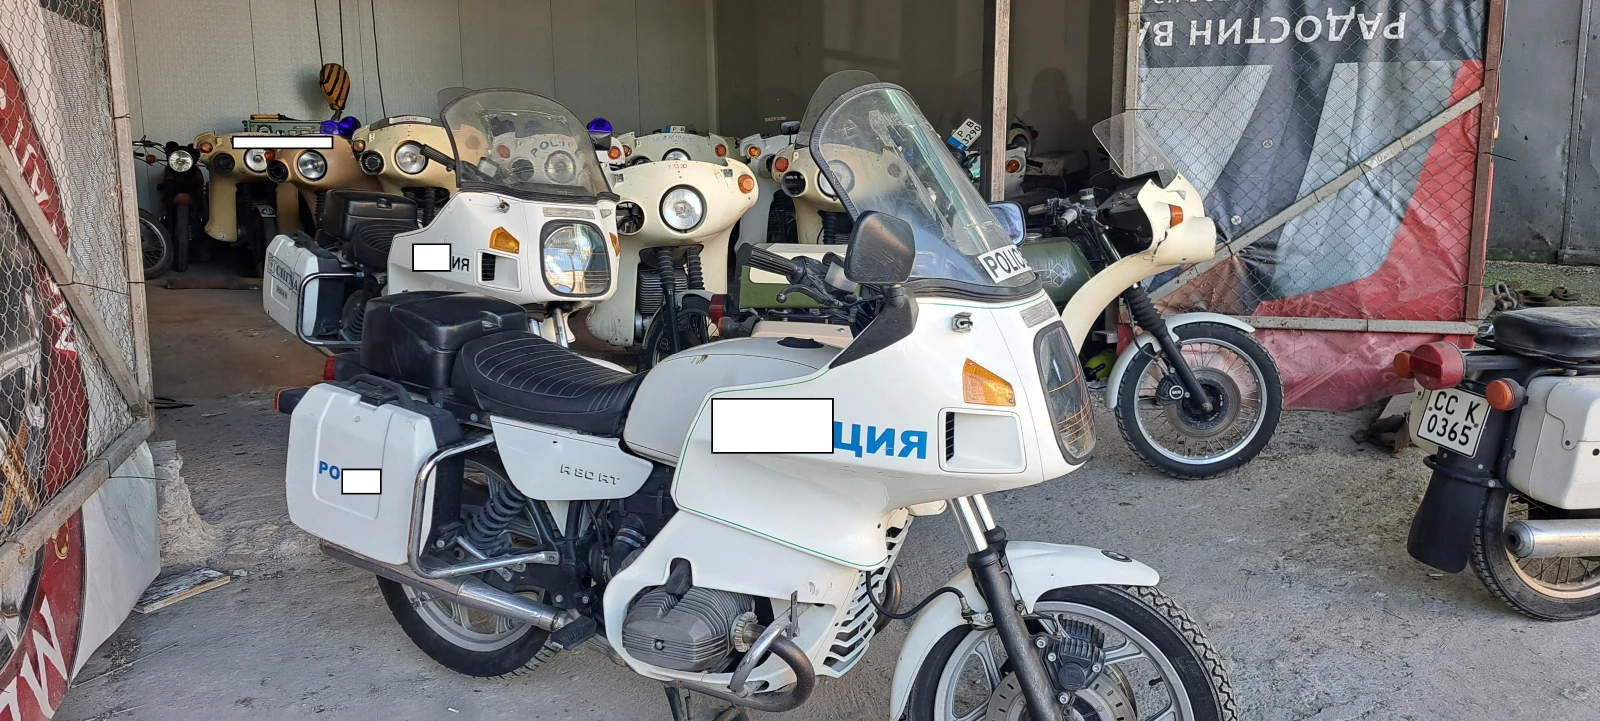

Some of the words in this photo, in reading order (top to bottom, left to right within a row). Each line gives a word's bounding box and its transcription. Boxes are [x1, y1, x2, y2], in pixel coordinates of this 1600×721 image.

[1189, 6, 1406, 47] РАДОСТИН
[956, 130, 964, 138] P
[961, 125, 981, 145] 3290
[1434, 391, 1459, 415] CC
[1465, 400, 1481, 424] K
[1427, 414, 1472, 446] 0365
[560, 463, 571, 475] R
[598, 472, 620, 485] RT
